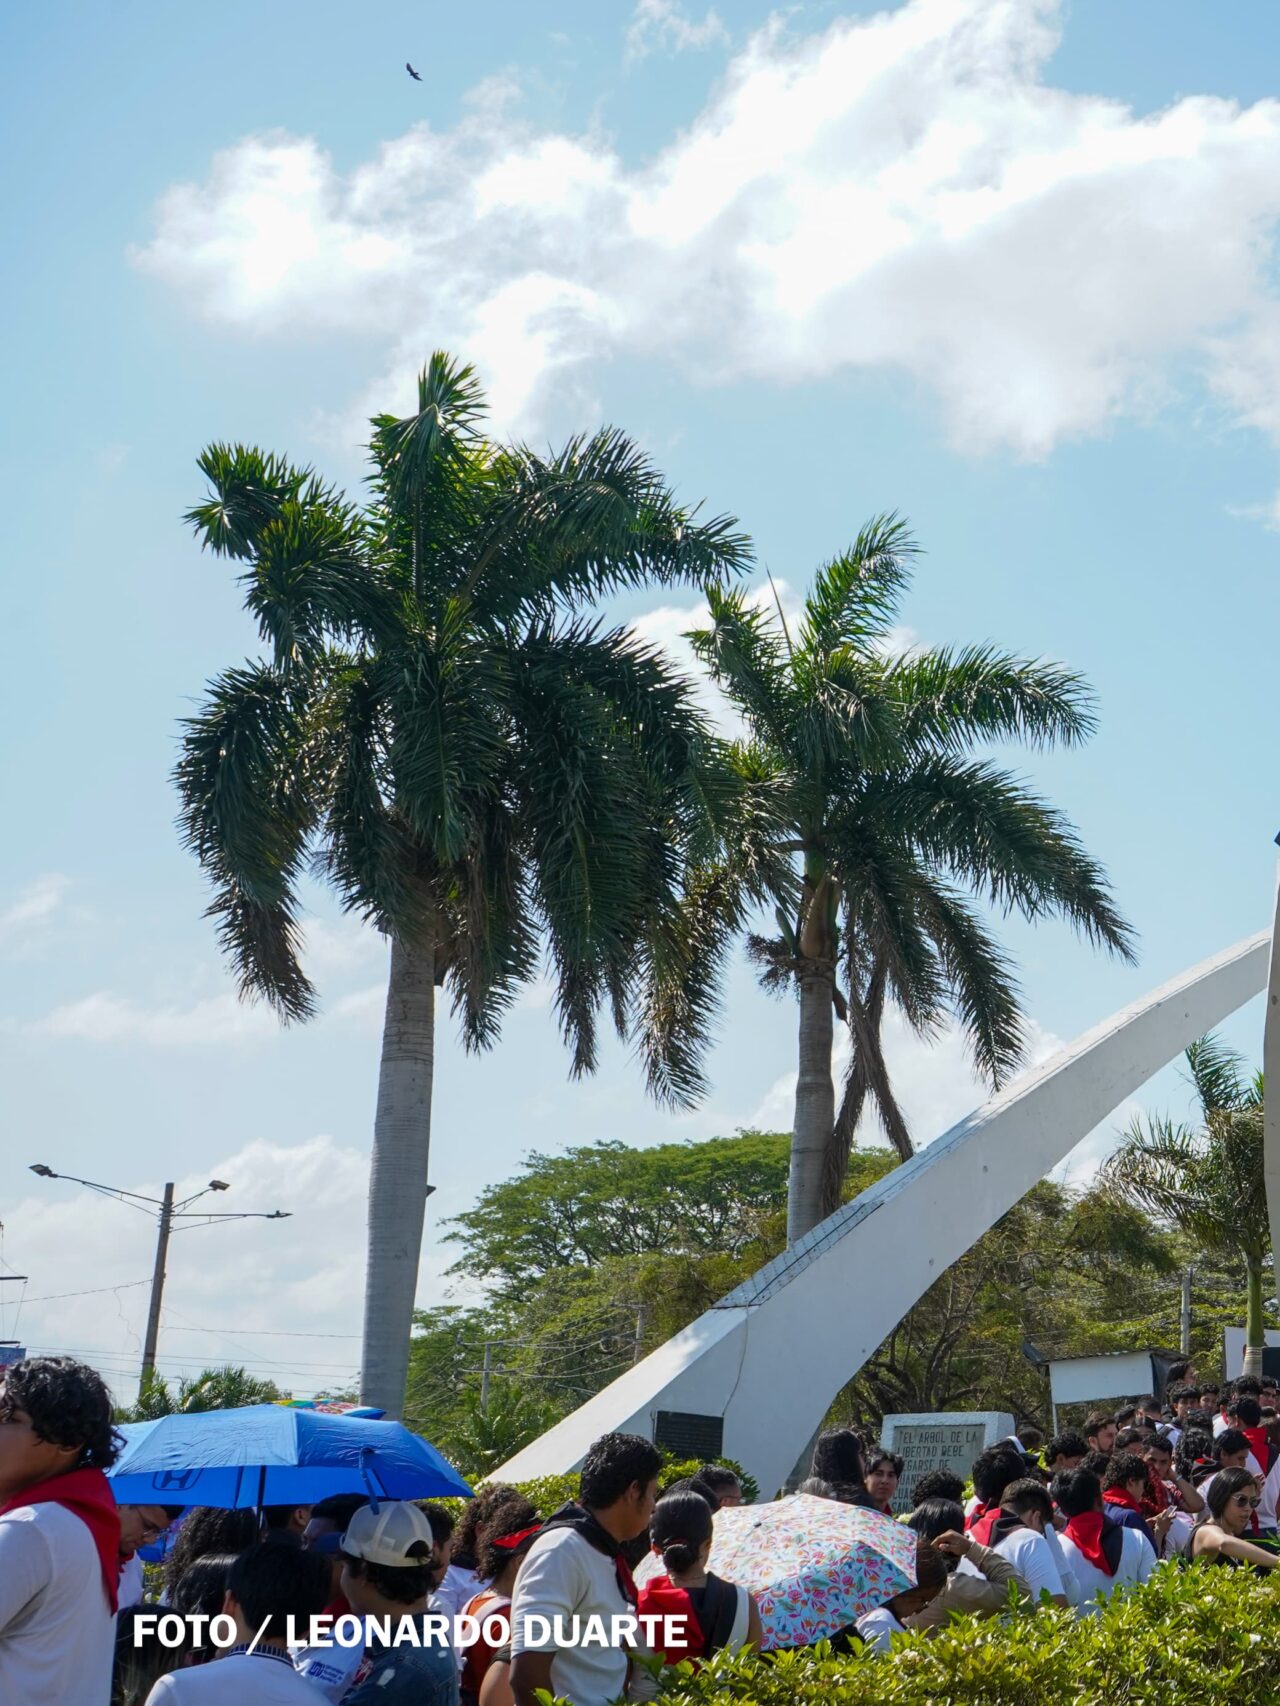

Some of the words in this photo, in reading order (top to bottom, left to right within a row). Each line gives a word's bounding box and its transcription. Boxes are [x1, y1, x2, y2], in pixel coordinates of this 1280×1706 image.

[918, 1431, 946, 1444] ARBOL
[951, 1431, 962, 1443] DE
[966, 1430, 977, 1442] LA
[902, 1459, 935, 1471] EGARSE
